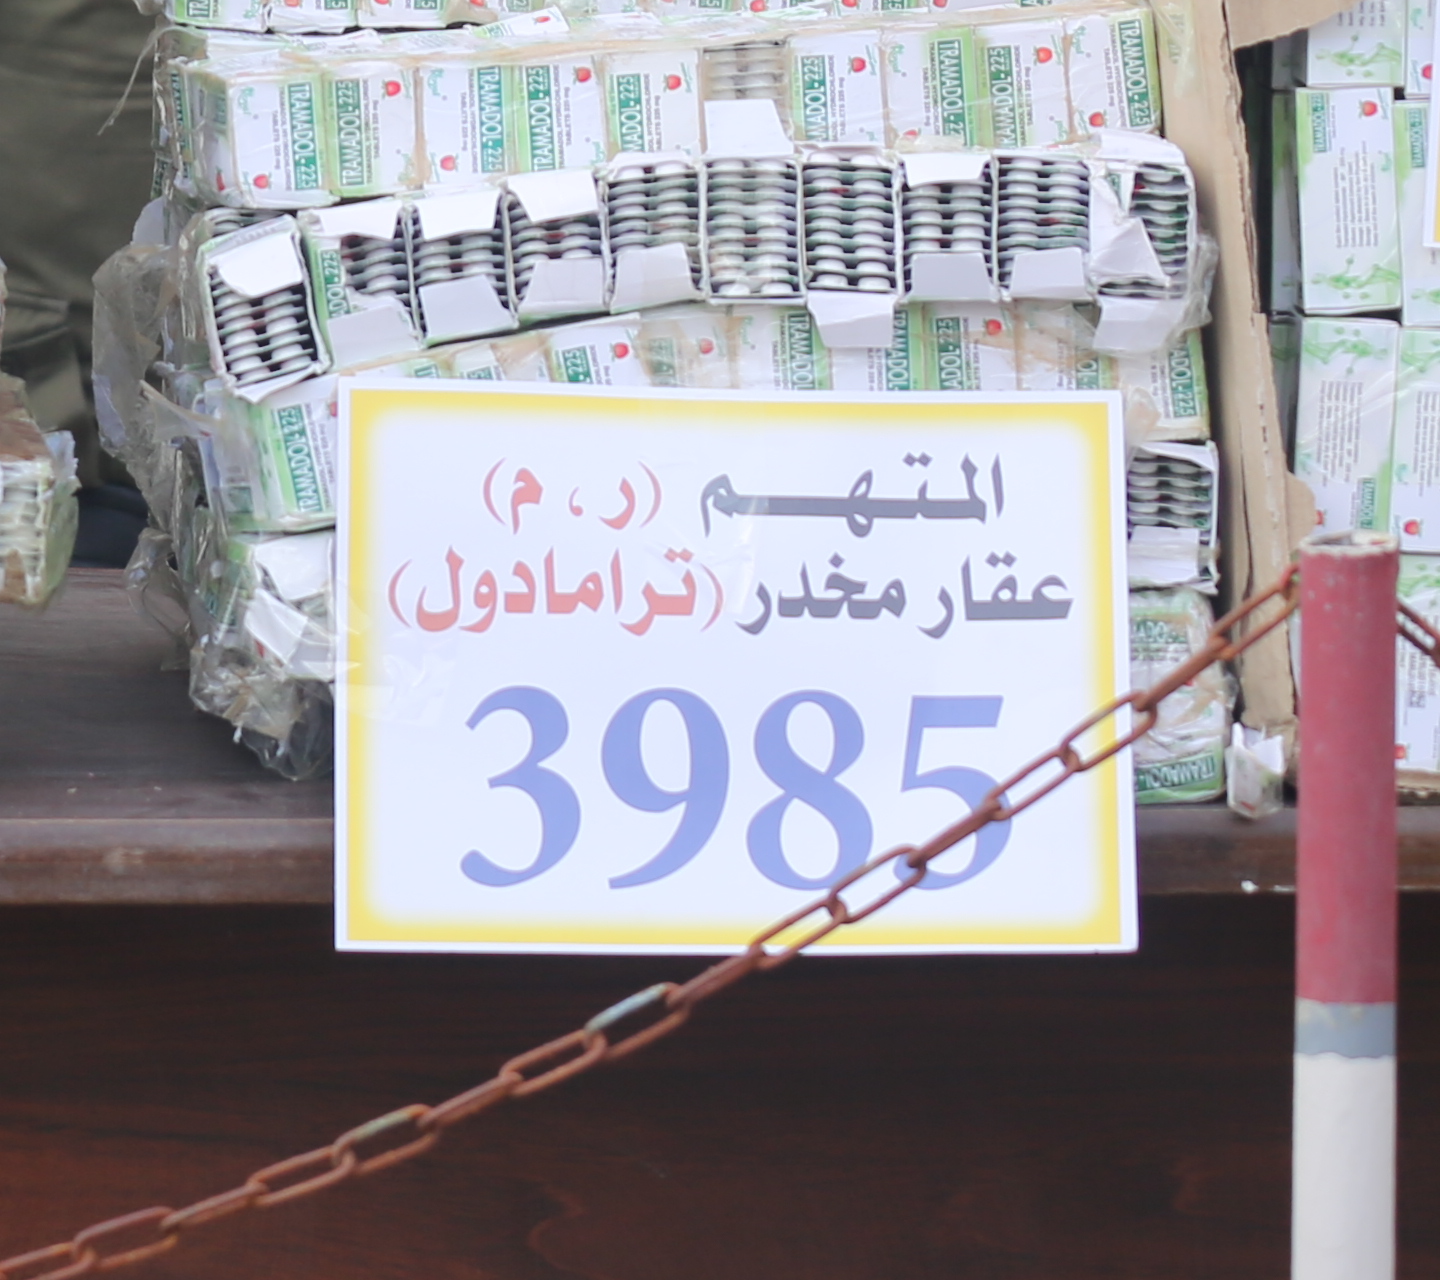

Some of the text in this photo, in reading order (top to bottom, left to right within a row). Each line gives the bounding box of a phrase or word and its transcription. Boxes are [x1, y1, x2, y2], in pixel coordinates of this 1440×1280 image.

[478, 67, 504, 171] TRAMADOL-225
[527, 66, 554, 170] TRAMADOL-225
[617, 75, 645, 151] MADOL-225
[802, 57, 831, 141] MADOL-225
[938, 40, 966, 138] TRAMADOL-22
[989, 47, 1019, 146] RAMADOL-225
[1120, 20, 1151, 125] TRAMADOL-225
[289, 84, 318, 189] TRAMADOL-225
[336, 80, 363, 185] TRAMADOL-225
[320, 248, 348, 318] ADOL-225
[790, 315, 816, 390] TRAMADOL
[937, 318, 964, 389] ADOL-225
[1164, 346, 1196, 416] ADOL-225
[387, 548, 1072, 639] عقار مخدر (ترامادول)
[461, 687, 1014, 892] 3985
